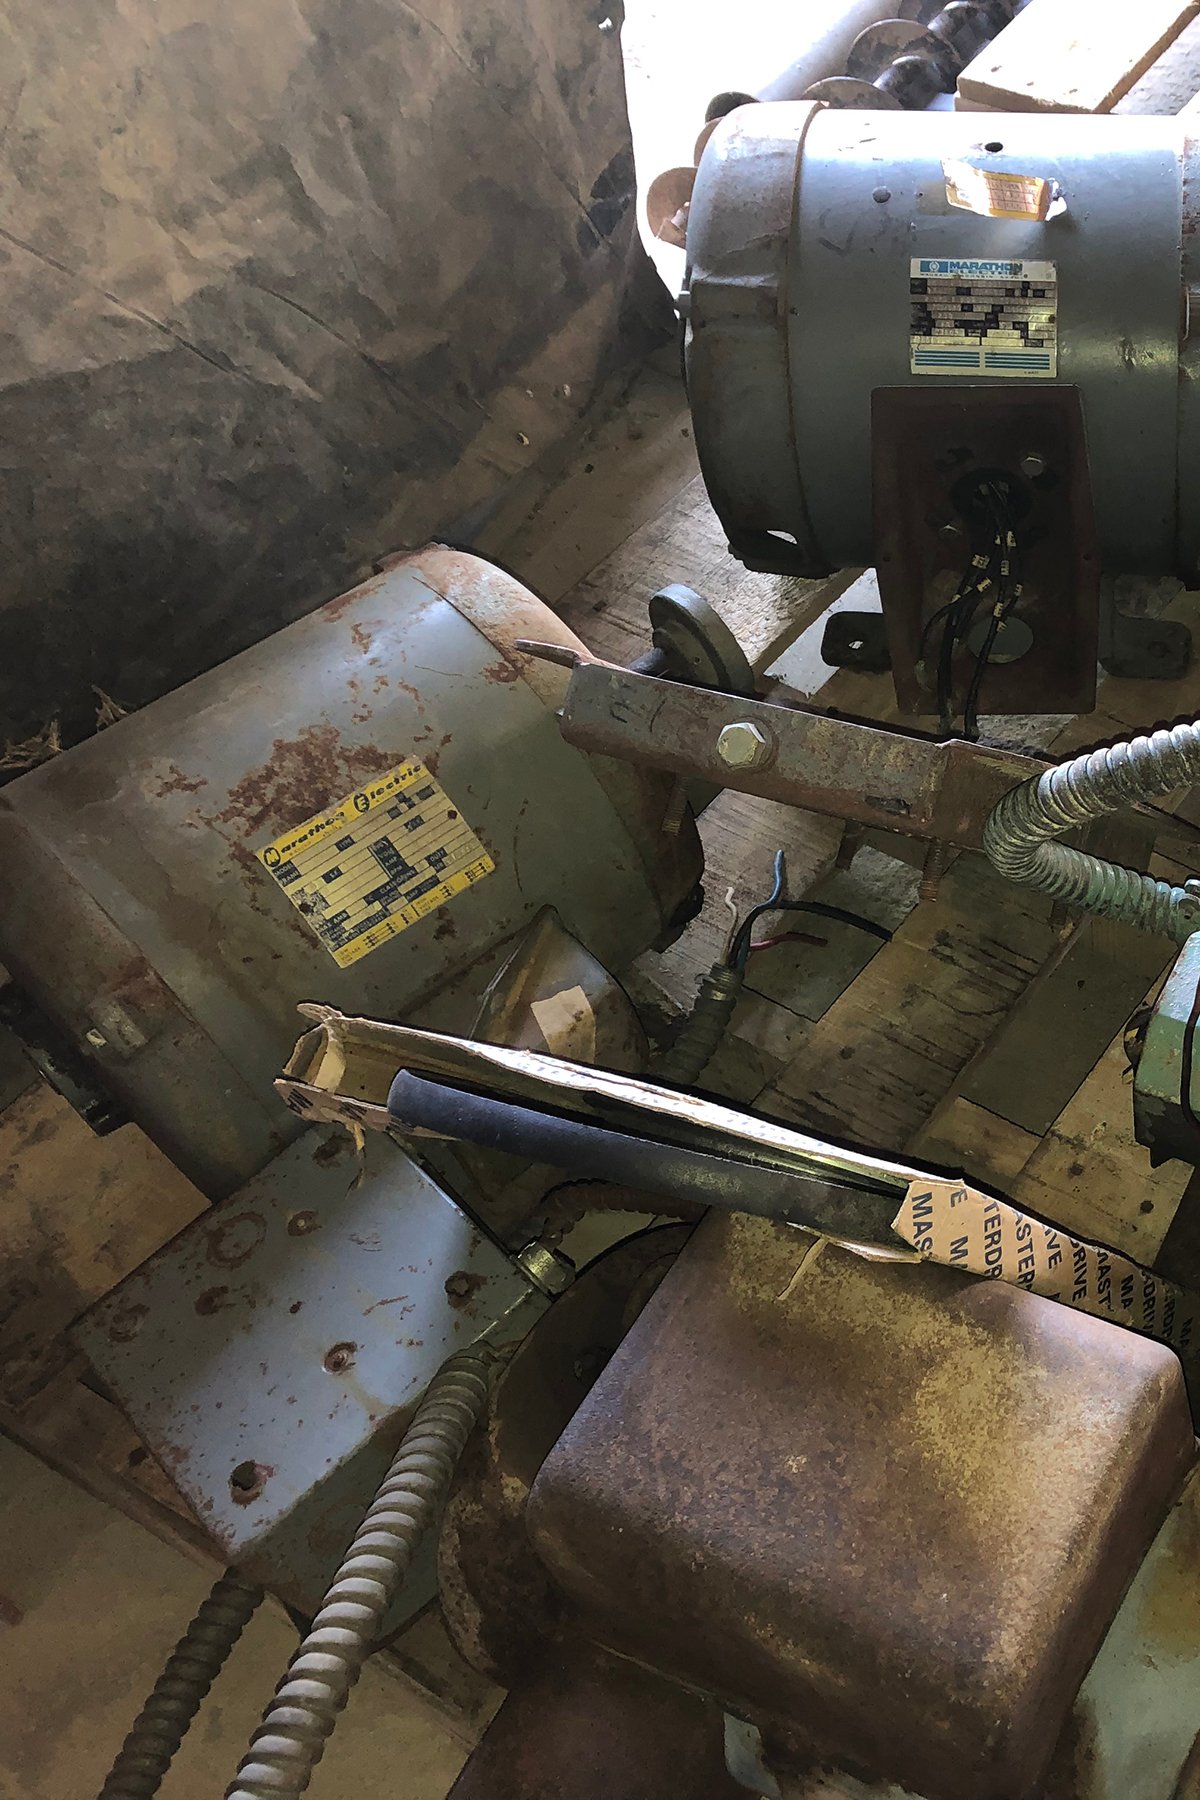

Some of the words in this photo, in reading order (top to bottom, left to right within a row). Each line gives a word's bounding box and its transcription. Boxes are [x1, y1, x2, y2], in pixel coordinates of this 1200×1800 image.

[950, 261, 1023, 272] MARATHON
[353, 764, 422, 813] Electric
[982, 1195, 1003, 1280] TERDR
